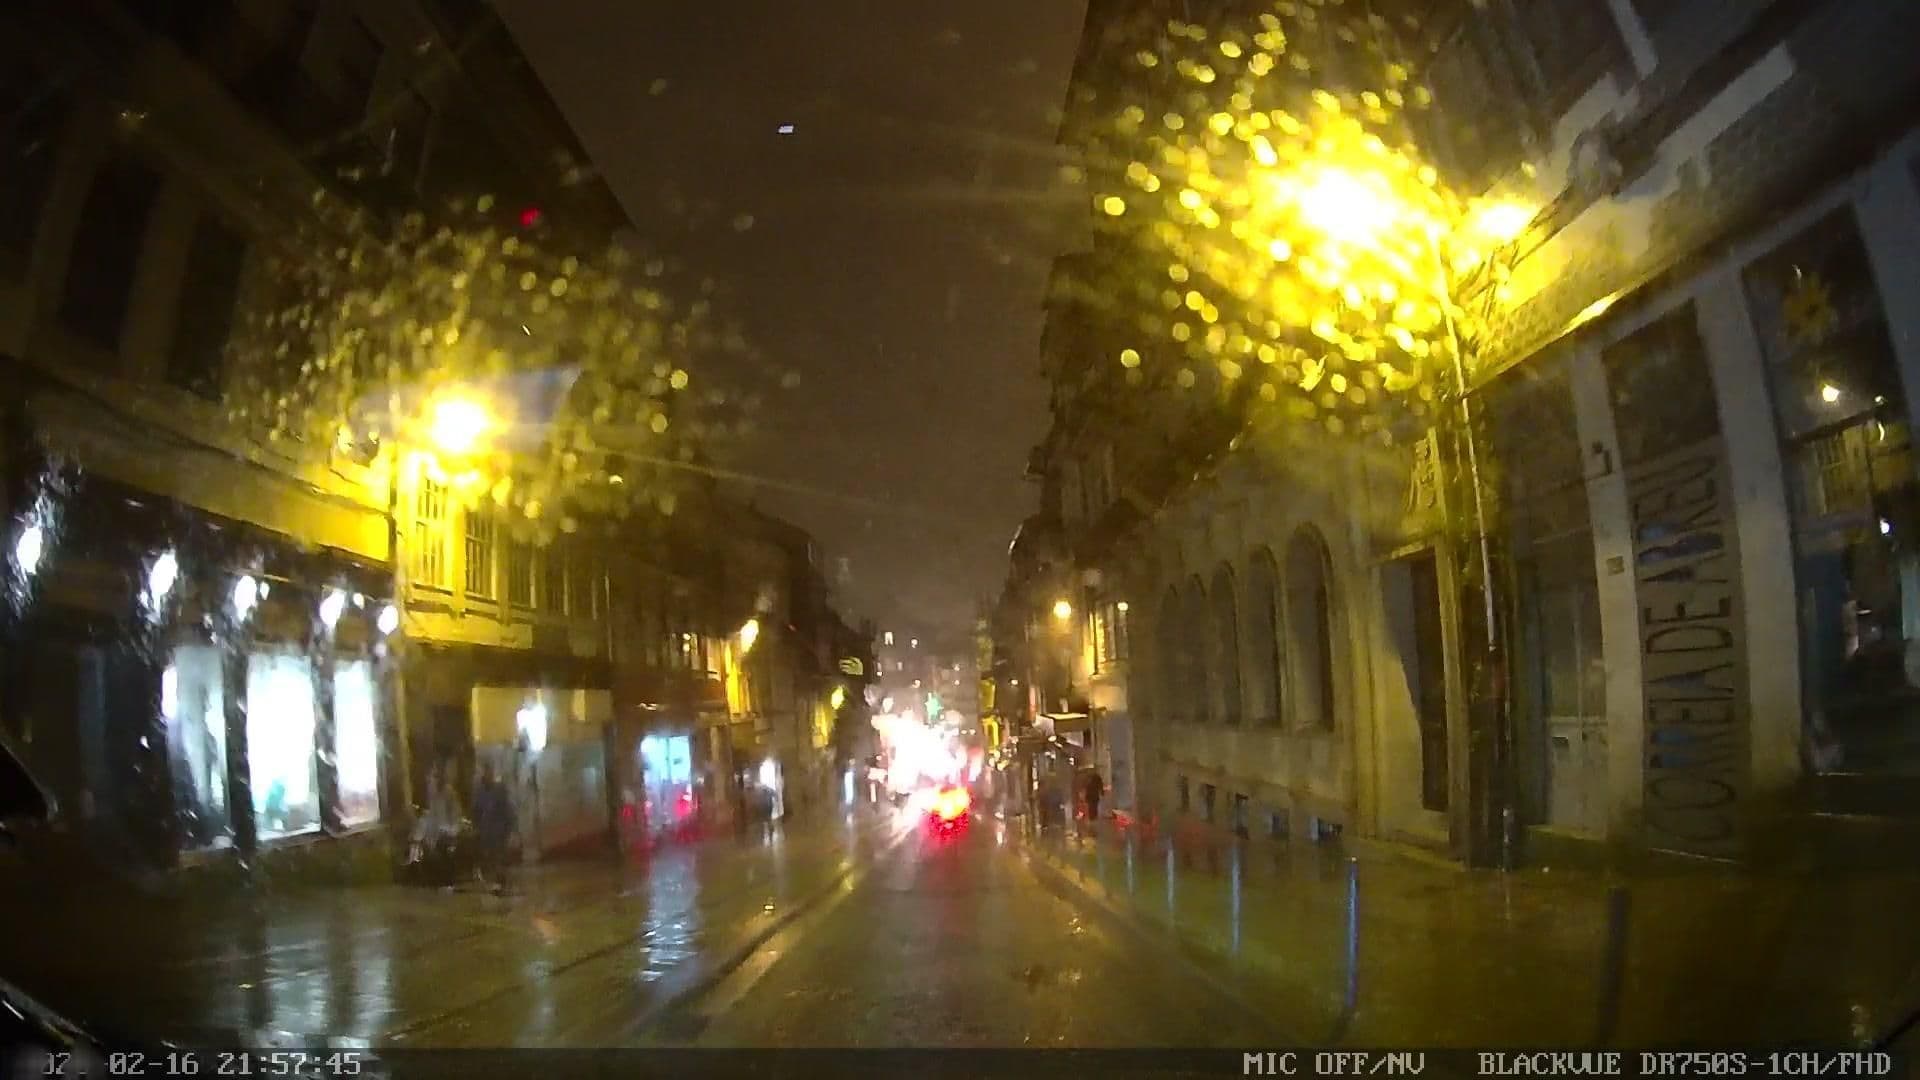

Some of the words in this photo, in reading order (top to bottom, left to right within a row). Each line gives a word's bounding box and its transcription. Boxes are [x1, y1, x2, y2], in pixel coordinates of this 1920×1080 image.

[1631, 455, 1729, 584] ABREU
[1645, 596, 1734, 654] DE
[1647, 663, 1736, 841] CORREIA
